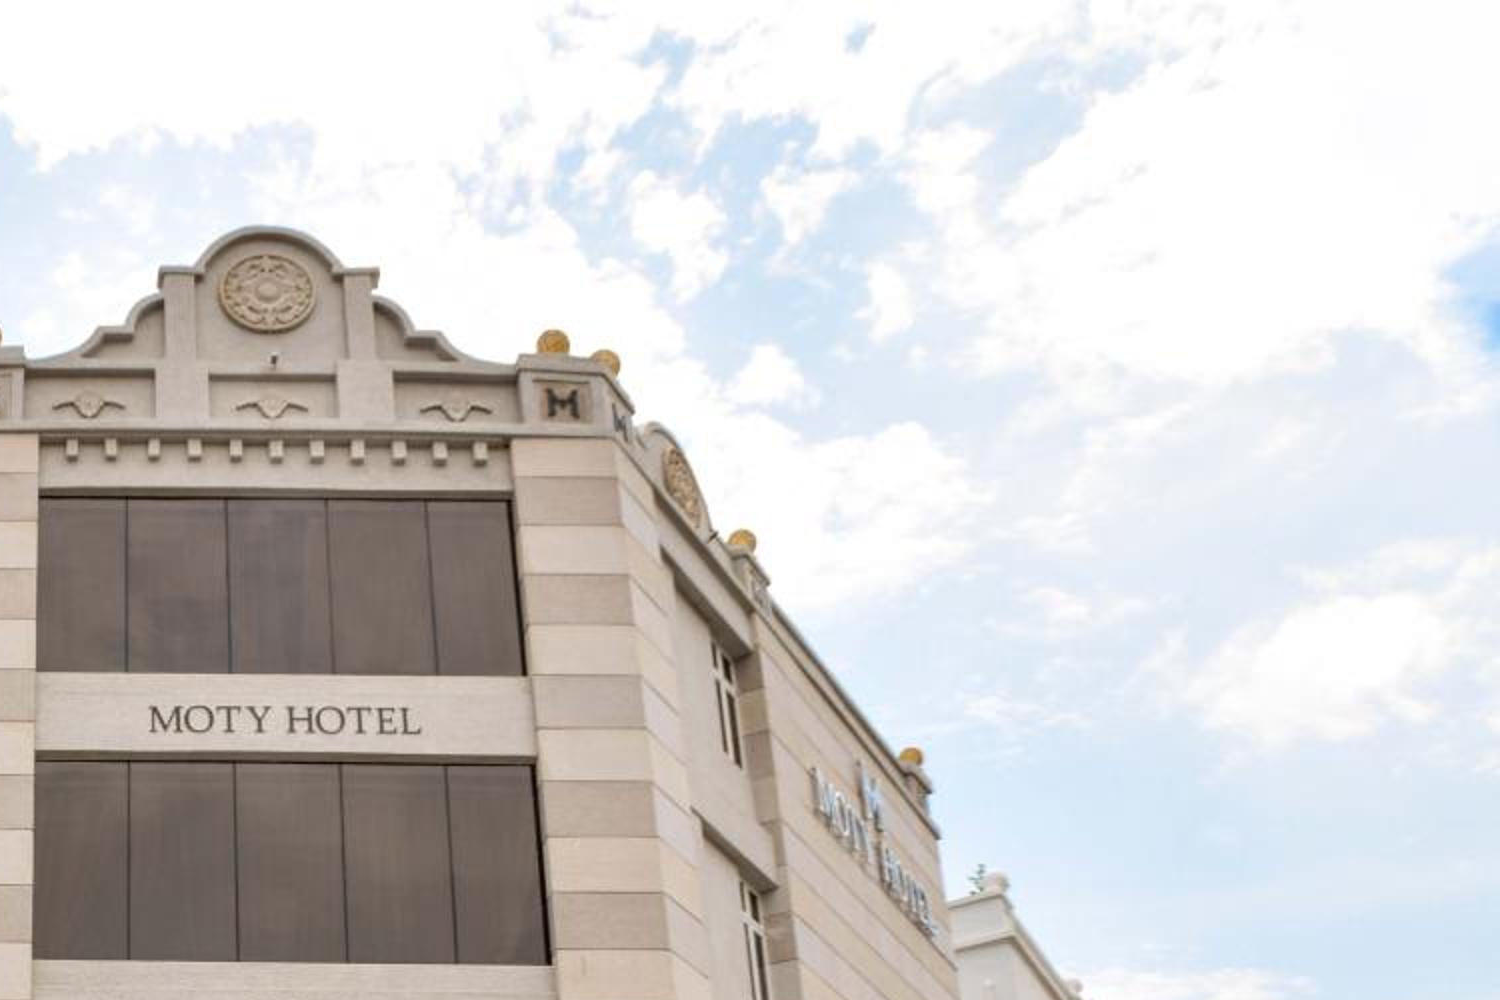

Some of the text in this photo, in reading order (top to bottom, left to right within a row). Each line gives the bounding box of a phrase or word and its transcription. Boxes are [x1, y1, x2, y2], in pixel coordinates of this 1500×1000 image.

[546, 388, 580, 419] M
[149, 705, 421, 736] MOTY HOTEL
